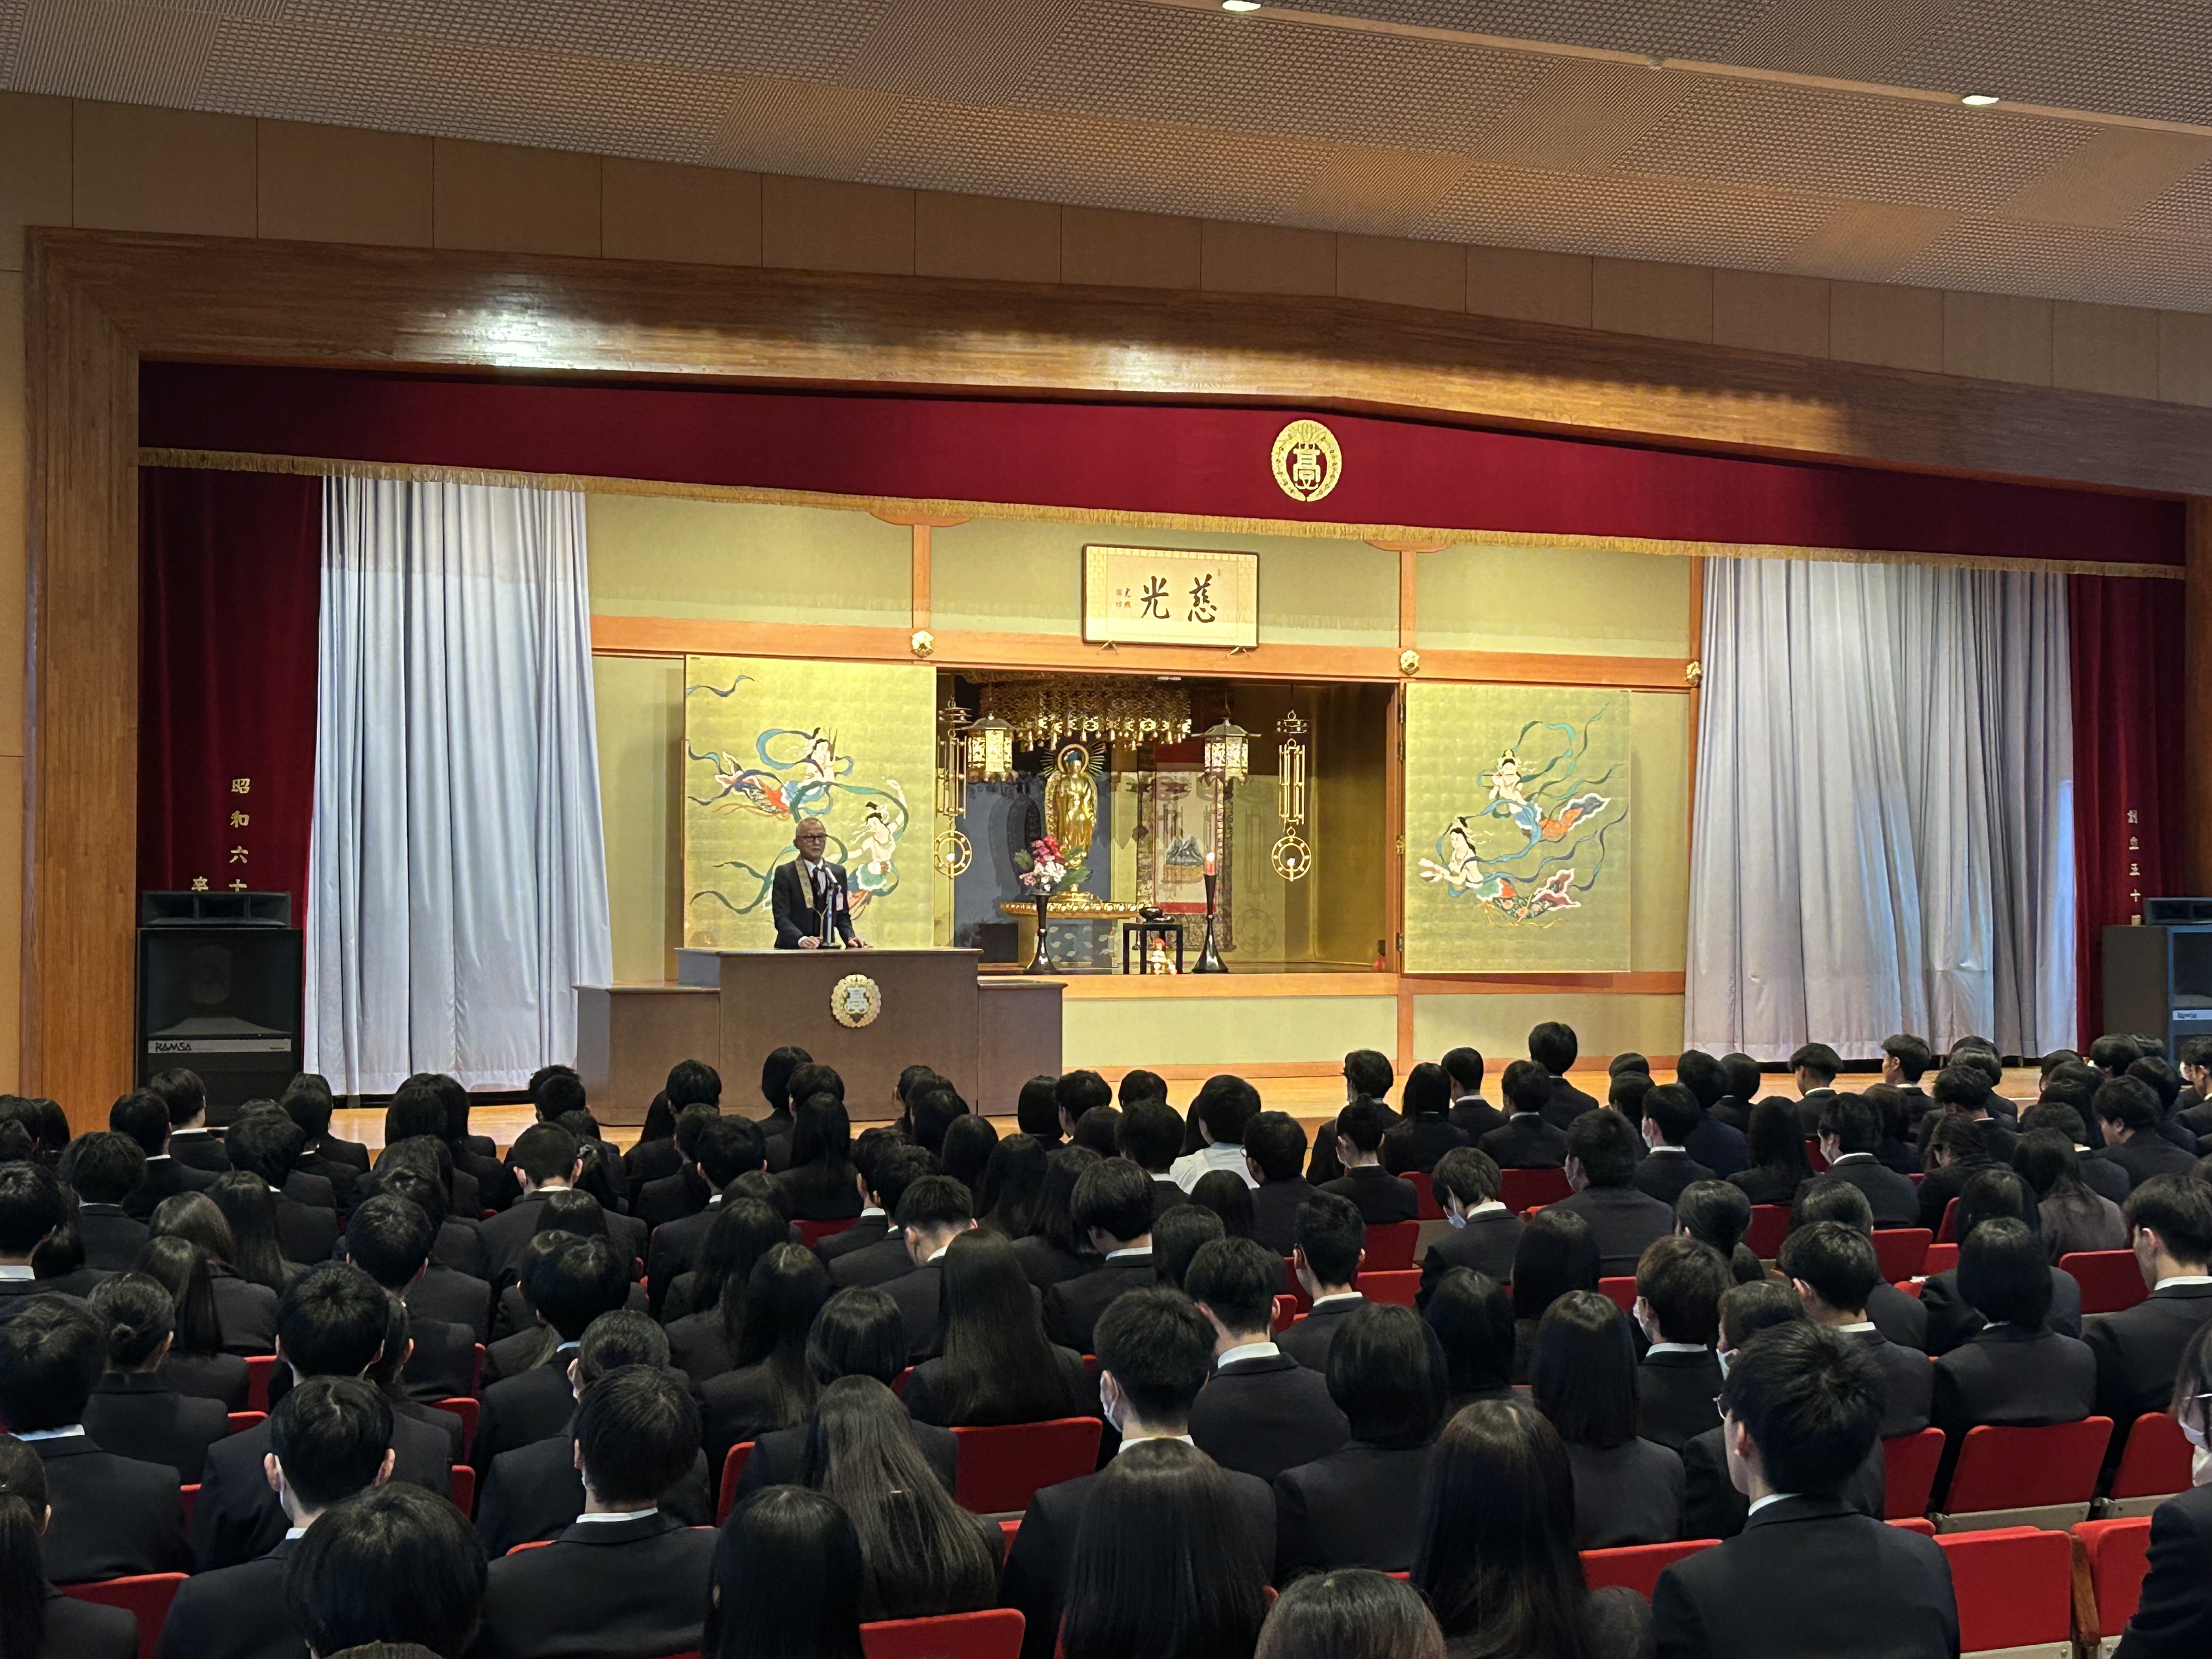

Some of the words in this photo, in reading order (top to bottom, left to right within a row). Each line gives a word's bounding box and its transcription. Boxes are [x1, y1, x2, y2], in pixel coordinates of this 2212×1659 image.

[1140, 573, 1217, 623] 慈光
[228, 778, 250, 891] 昭和六十
[155, 1042, 192, 1052] RAMSA
